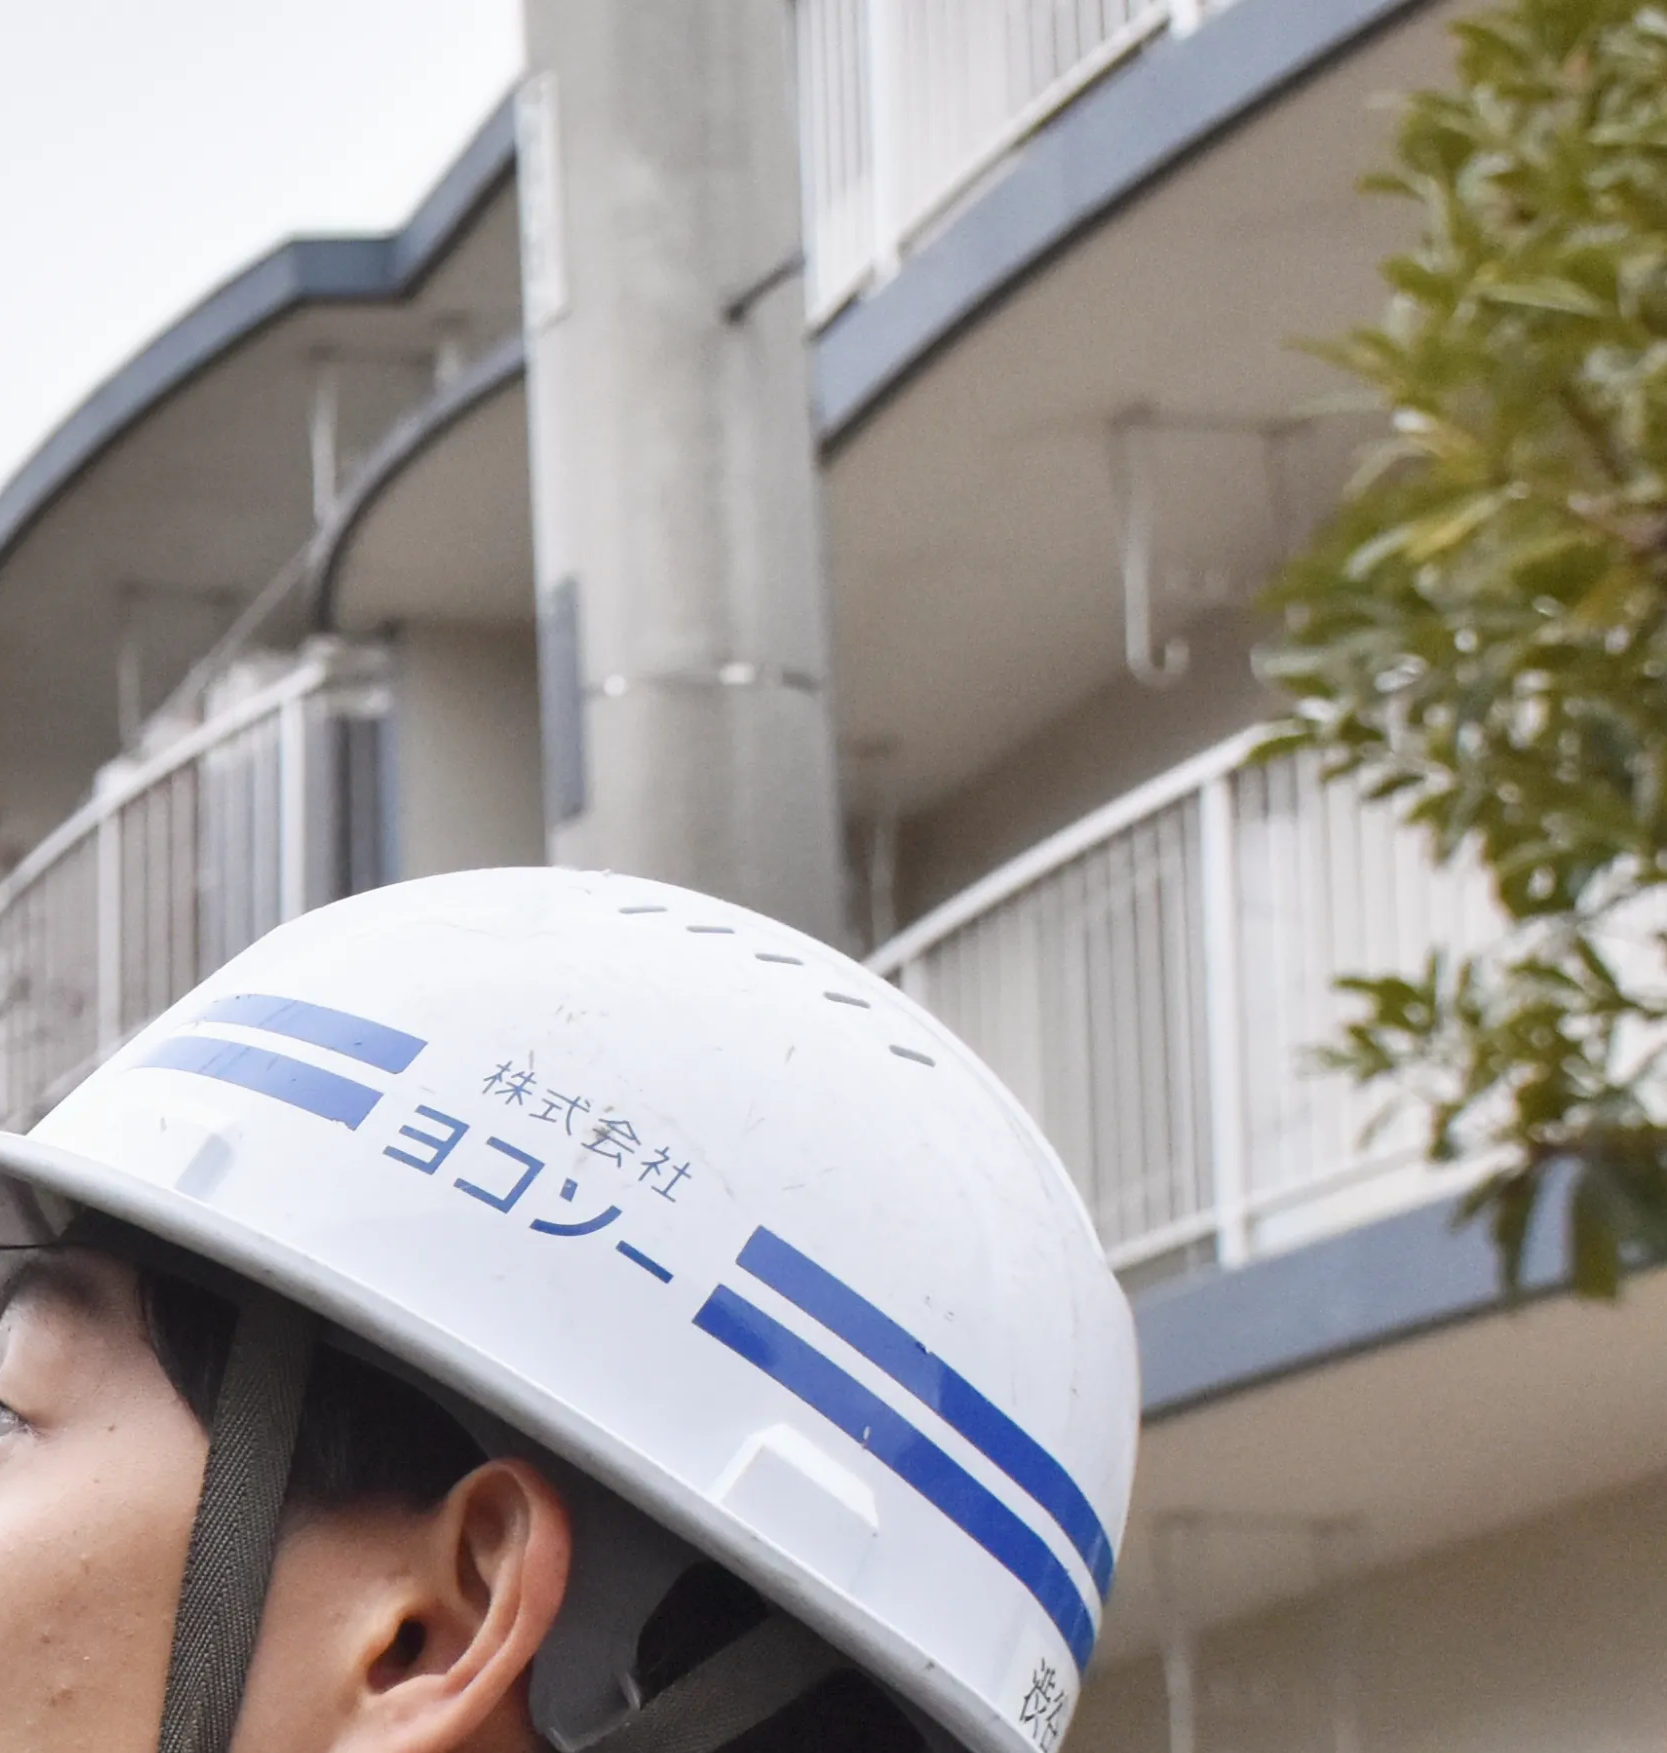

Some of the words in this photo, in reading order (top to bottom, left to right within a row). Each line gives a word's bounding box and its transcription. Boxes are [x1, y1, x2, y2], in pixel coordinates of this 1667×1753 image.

[382, 1104, 674, 1285] ヨコソー
[482, 1060, 692, 1203] 株式会社
